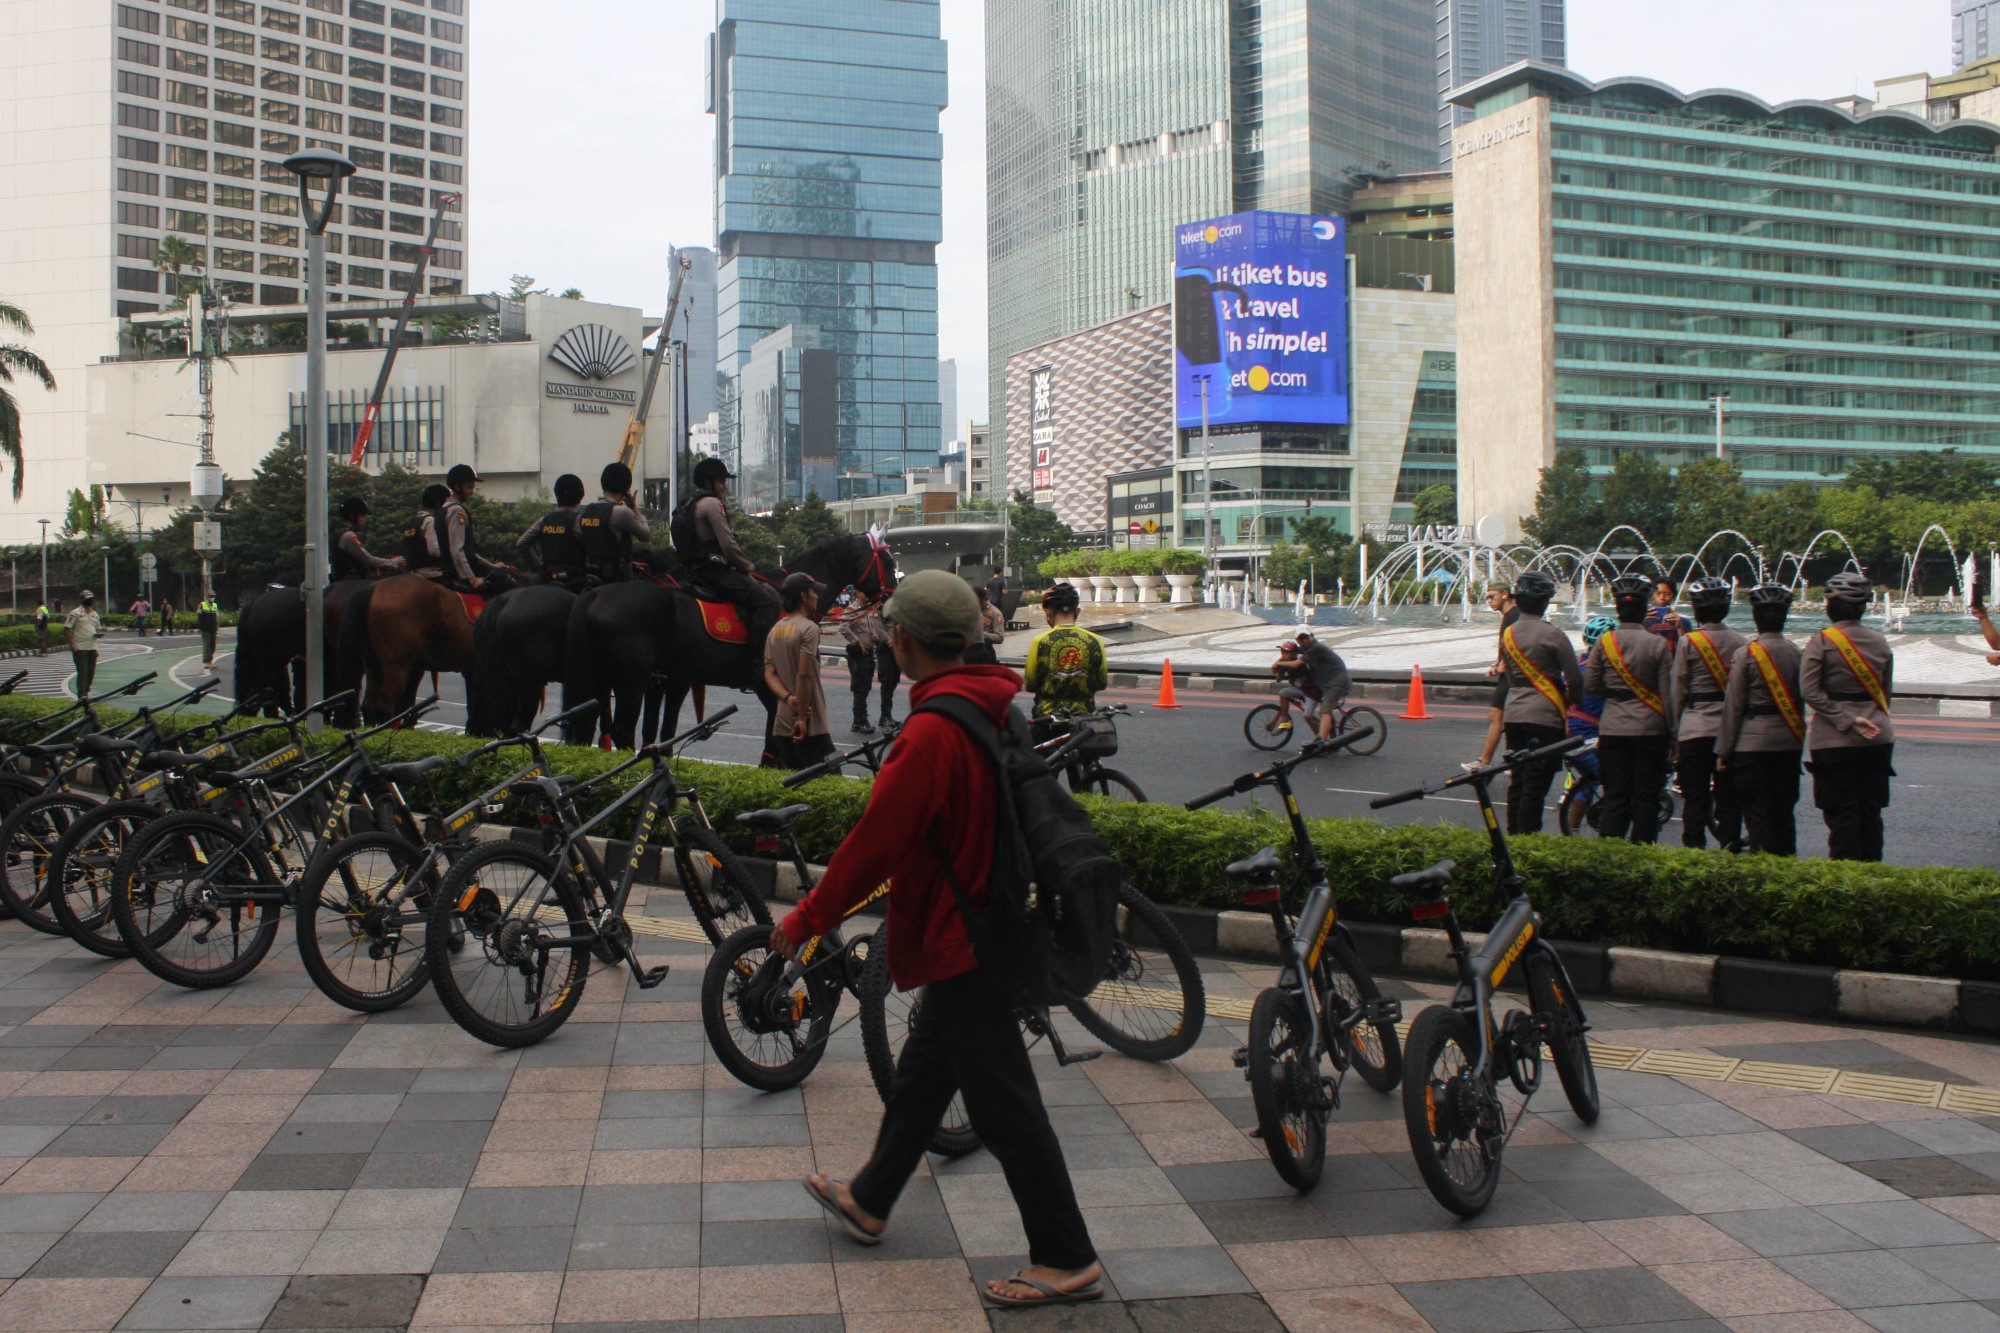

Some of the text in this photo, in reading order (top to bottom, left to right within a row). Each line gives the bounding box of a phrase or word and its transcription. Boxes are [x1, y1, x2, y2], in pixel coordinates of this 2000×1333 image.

[1456, 116, 1531, 159] KEMPINSKI
[1231, 262, 1283, 287] tiket
[1287, 264, 1328, 289] bus
[1246, 327, 1328, 356] simple!
[546, 384, 635, 401] MANDARIN ORIENTAL
[573, 403, 609, 415] JAKARTA
[1134, 502, 1155, 510] COACH
[543, 525, 566, 535] POLISI
[581, 517, 601, 527] POLISI
[322, 781, 353, 839] POLISI
[630, 801, 659, 871] POLISI
